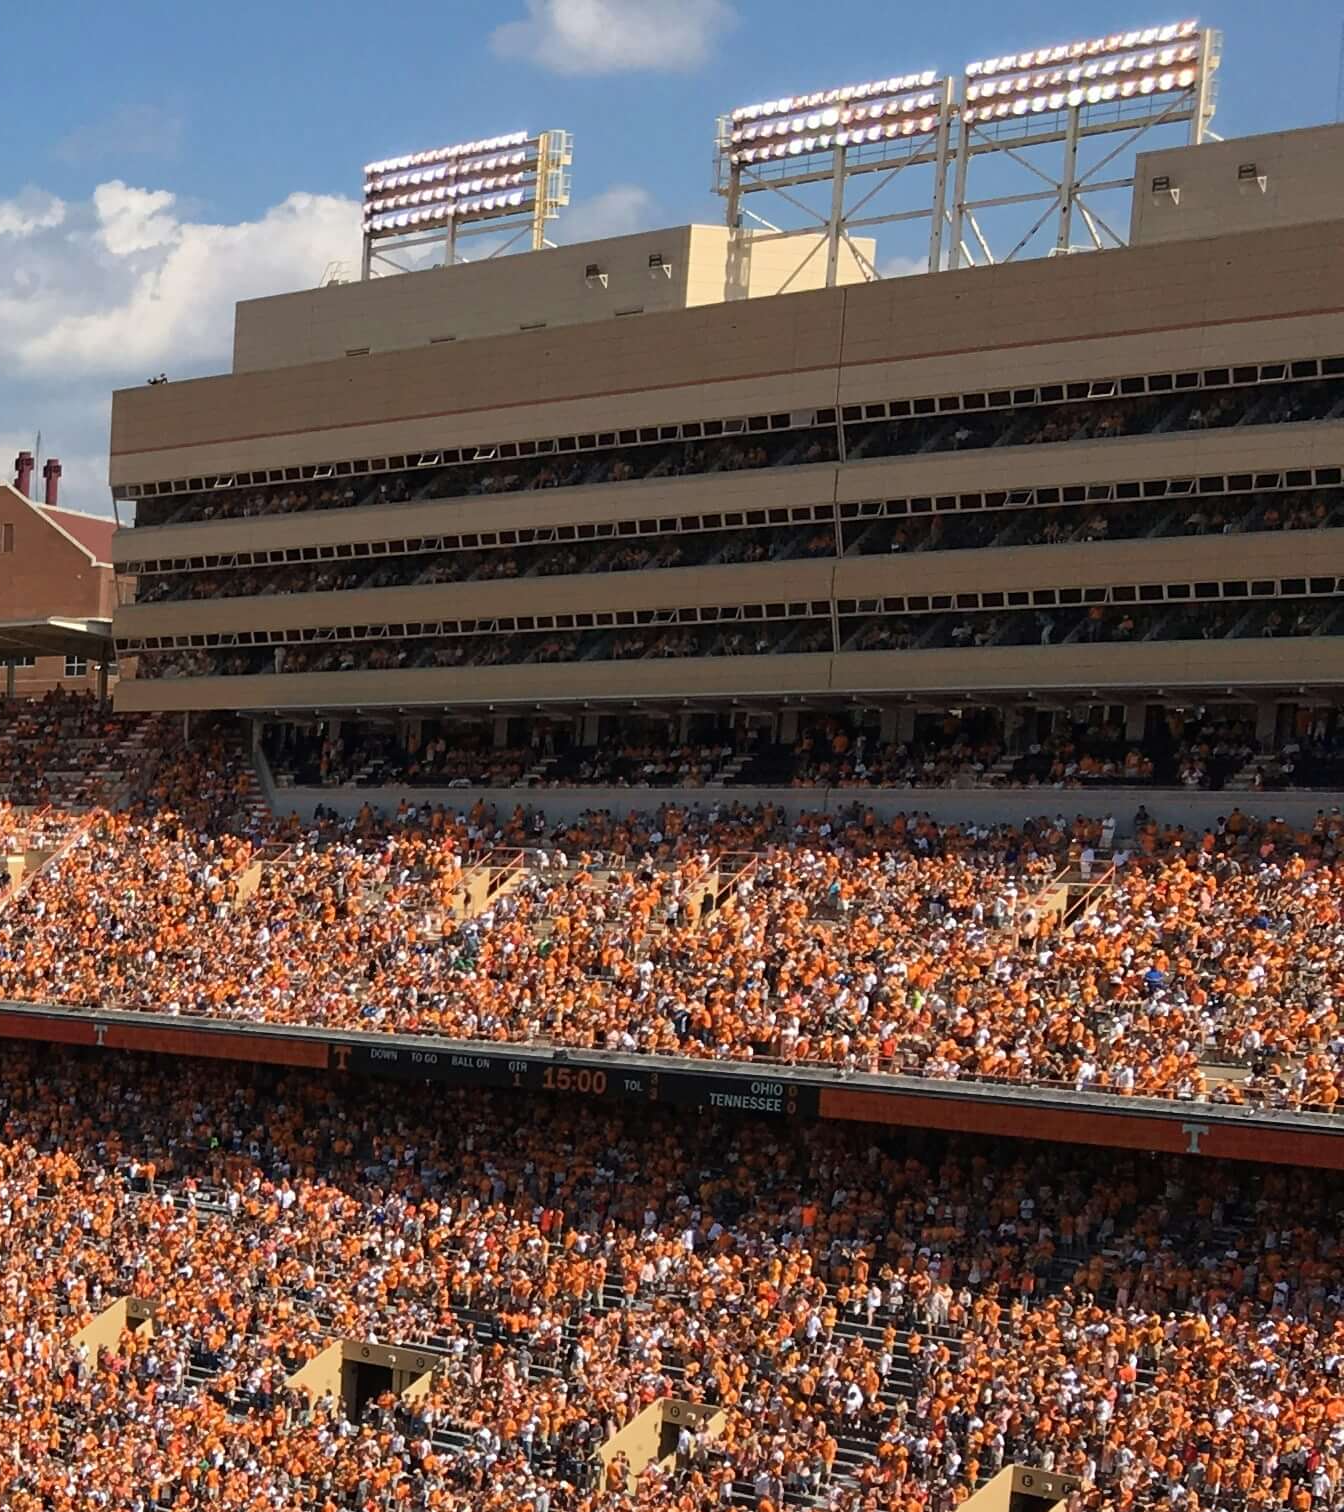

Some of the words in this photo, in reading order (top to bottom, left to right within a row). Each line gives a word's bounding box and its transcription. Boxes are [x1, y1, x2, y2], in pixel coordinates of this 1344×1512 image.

[370, 1047, 398, 1061] DOWN
[411, 1051, 422, 1063] TO
[423, 1052, 439, 1064] GO
[451, 1055, 474, 1069] BALL
[476, 1057, 491, 1070] ON
[542, 1066, 608, 1095] 15:00
[624, 1079, 644, 1093] TOL
[750, 1081, 784, 1097] OHIO
[709, 1092, 783, 1113] TENNESSEE
[1182, 1123, 1209, 1153] T
